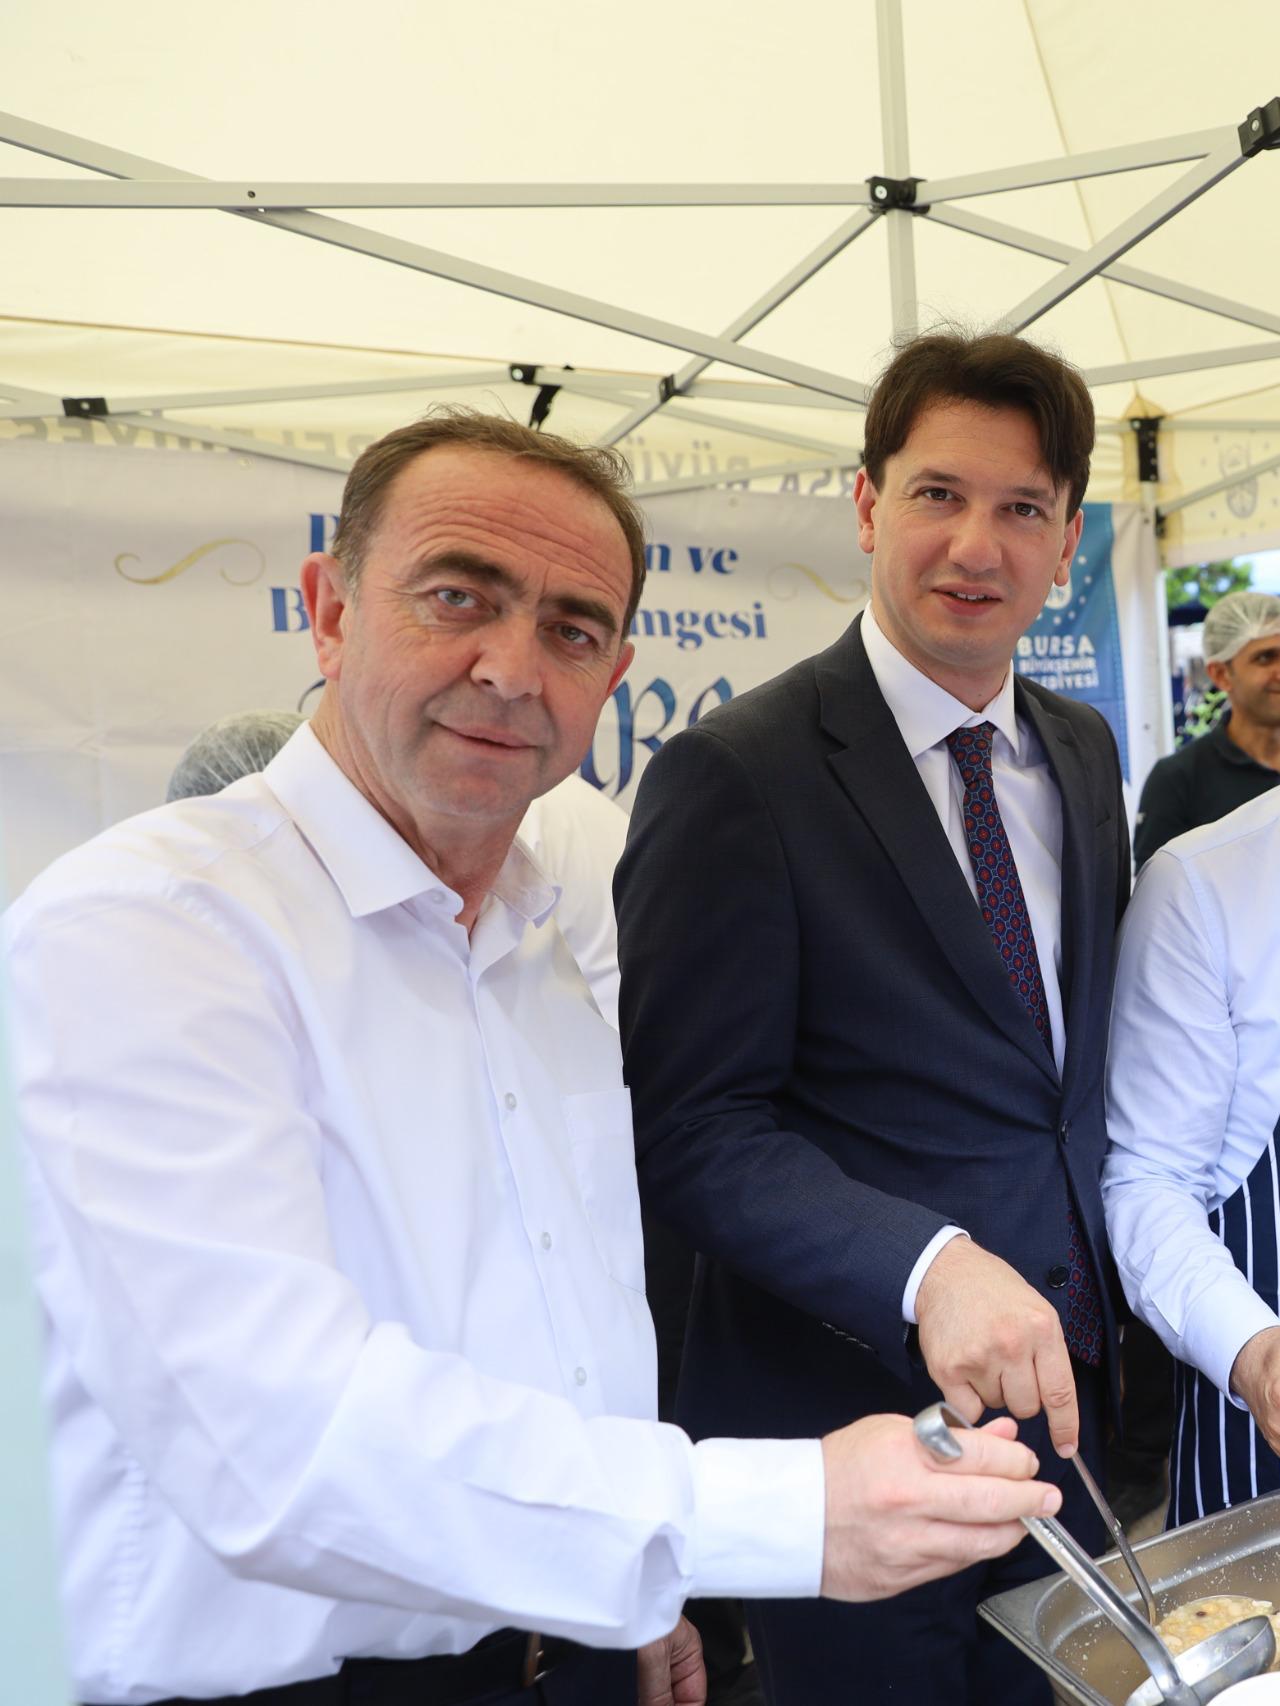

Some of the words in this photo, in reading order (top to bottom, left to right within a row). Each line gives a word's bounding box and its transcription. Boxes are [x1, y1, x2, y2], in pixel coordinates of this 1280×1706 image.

[687, 546, 739, 575] ve
[630, 601, 768, 650] mgesi
[1017, 635, 1096, 656] BURSA
